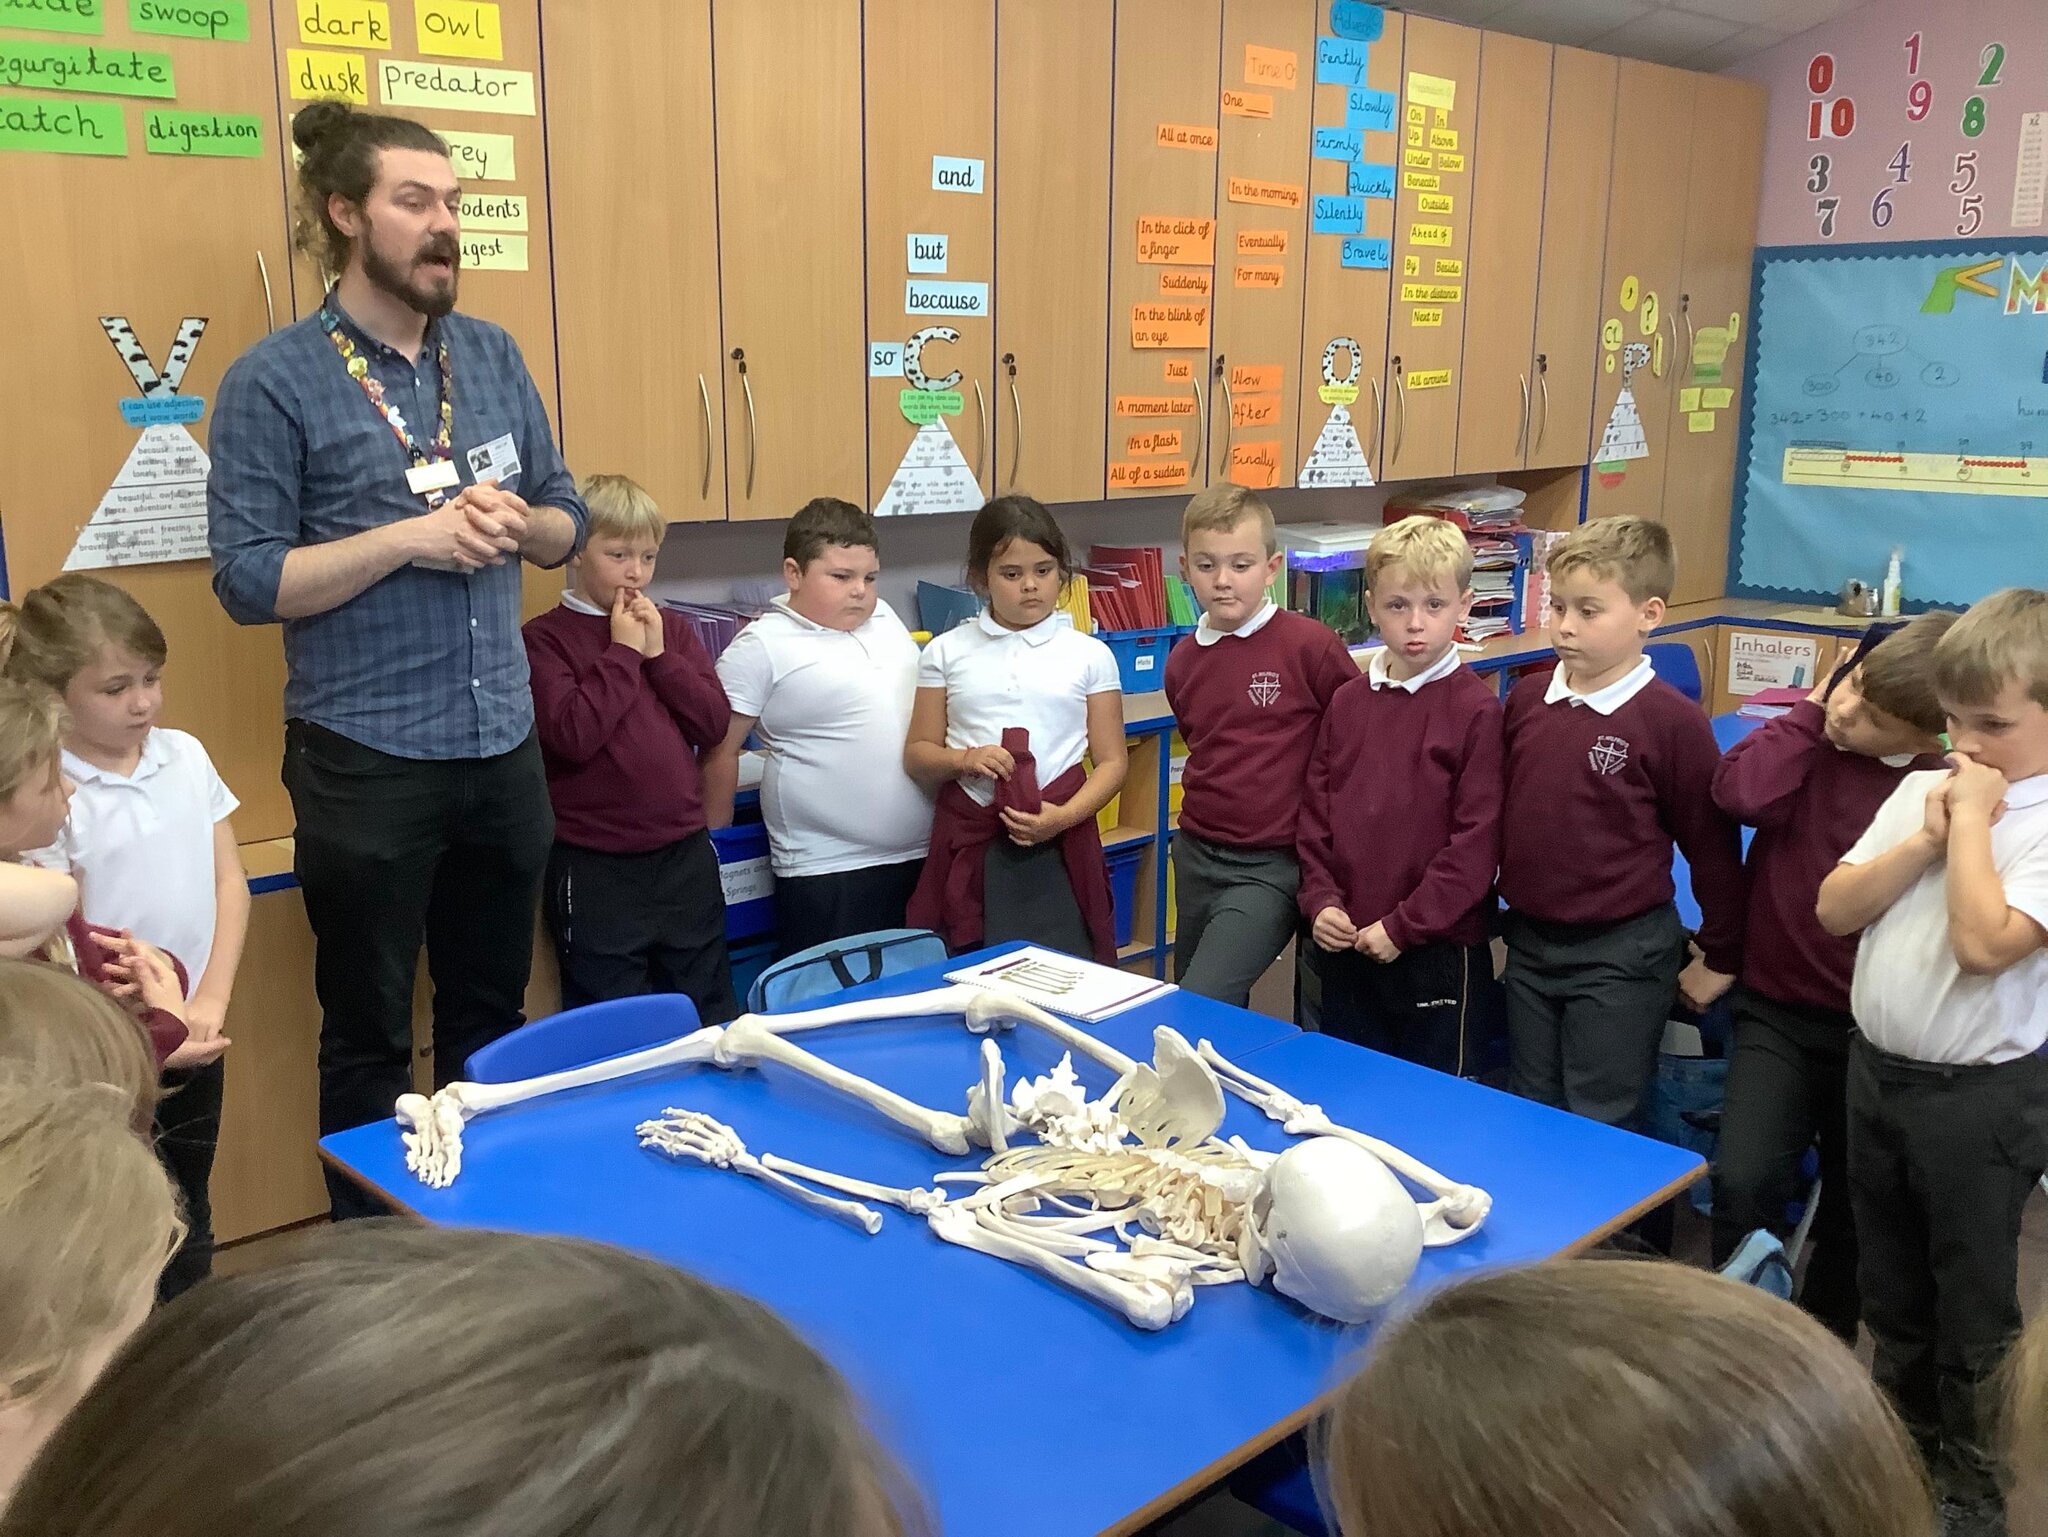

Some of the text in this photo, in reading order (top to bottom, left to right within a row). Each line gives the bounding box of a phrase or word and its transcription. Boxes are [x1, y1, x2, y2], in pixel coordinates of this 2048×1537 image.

[140, 2, 229, 39] swoop
[304, 2, 388, 42] dark
[1319, 40, 1364, 84] Gently
[1905, 33, 1920, 74] 1
[1977, 43, 2005, 86] 2
[0, 47, 167, 86] egurgitate
[300, 57, 364, 95] dusk
[1808, 54, 1834, 94] 0
[1223, 92, 1244, 108] One
[1350, 92, 1393, 129] Slowly
[1907, 80, 1932, 121] 9
[1409, 108, 1422, 121] On
[1808, 97, 1854, 139] 10
[1962, 96, 1986, 138] 8
[149, 115, 258, 152] digestion
[1160, 128, 1213, 146] All at once
[1408, 128, 1420, 144] Up
[1431, 133, 1455, 147] Above
[1315, 130, 1361, 161] Firmly
[449, 144, 487, 180] rey
[1406, 153, 1430, 166] Under
[1888, 141, 1911, 183] 4
[938, 165, 975, 188] and
[1407, 174, 1438, 188] Beneath
[1807, 154, 1830, 193] 3
[1950, 152, 1977, 193] 5
[1231, 182, 1242, 195] In
[1244, 184, 1259, 197] the
[462, 198, 520, 219] odents
[1421, 197, 1450, 210] Outside
[1872, 187, 1894, 228] 6
[1315, 198, 1363, 233] Silently
[1817, 198, 1839, 236] 7
[1956, 195, 1983, 236] 5
[1141, 220, 1210, 240] In the click of
[1411, 226, 1438, 239] Ahead
[462, 238, 504, 266] igest
[914, 238, 945, 261] but
[1140, 241, 1180, 259] a finger
[1239, 234, 1286, 251] Eventually
[1342, 241, 1388, 267] Bravely
[1237, 268, 1280, 286] For many
[1406, 258, 1417, 274] By
[1436, 261, 1459, 274] Beside
[1162, 275, 1208, 294] Suddenly
[1403, 287, 1458, 299] In the distance
[2003, 257, 2048, 315] M
[909, 287, 980, 311] because
[1134, 308, 1206, 326] In the blink of
[1413, 310, 1441, 322] Next to
[1135, 331, 1169, 346] an eye
[98, 317, 209, 398] V
[873, 349, 897, 367] so
[903, 326, 964, 391] C
[1167, 364, 1188, 377] Just
[1233, 369, 1261, 385] Now
[1410, 372, 1449, 387] All around
[1117, 400, 1193, 414] A moment later
[1232, 403, 1271, 426] After
[1129, 433, 1179, 452] In a flash
[1111, 464, 1186, 484] All of a sudden
[1231, 447, 1275, 486] Finally
[1734, 636, 1811, 657] Inhalers
[720, 866, 750, 882] agnets
